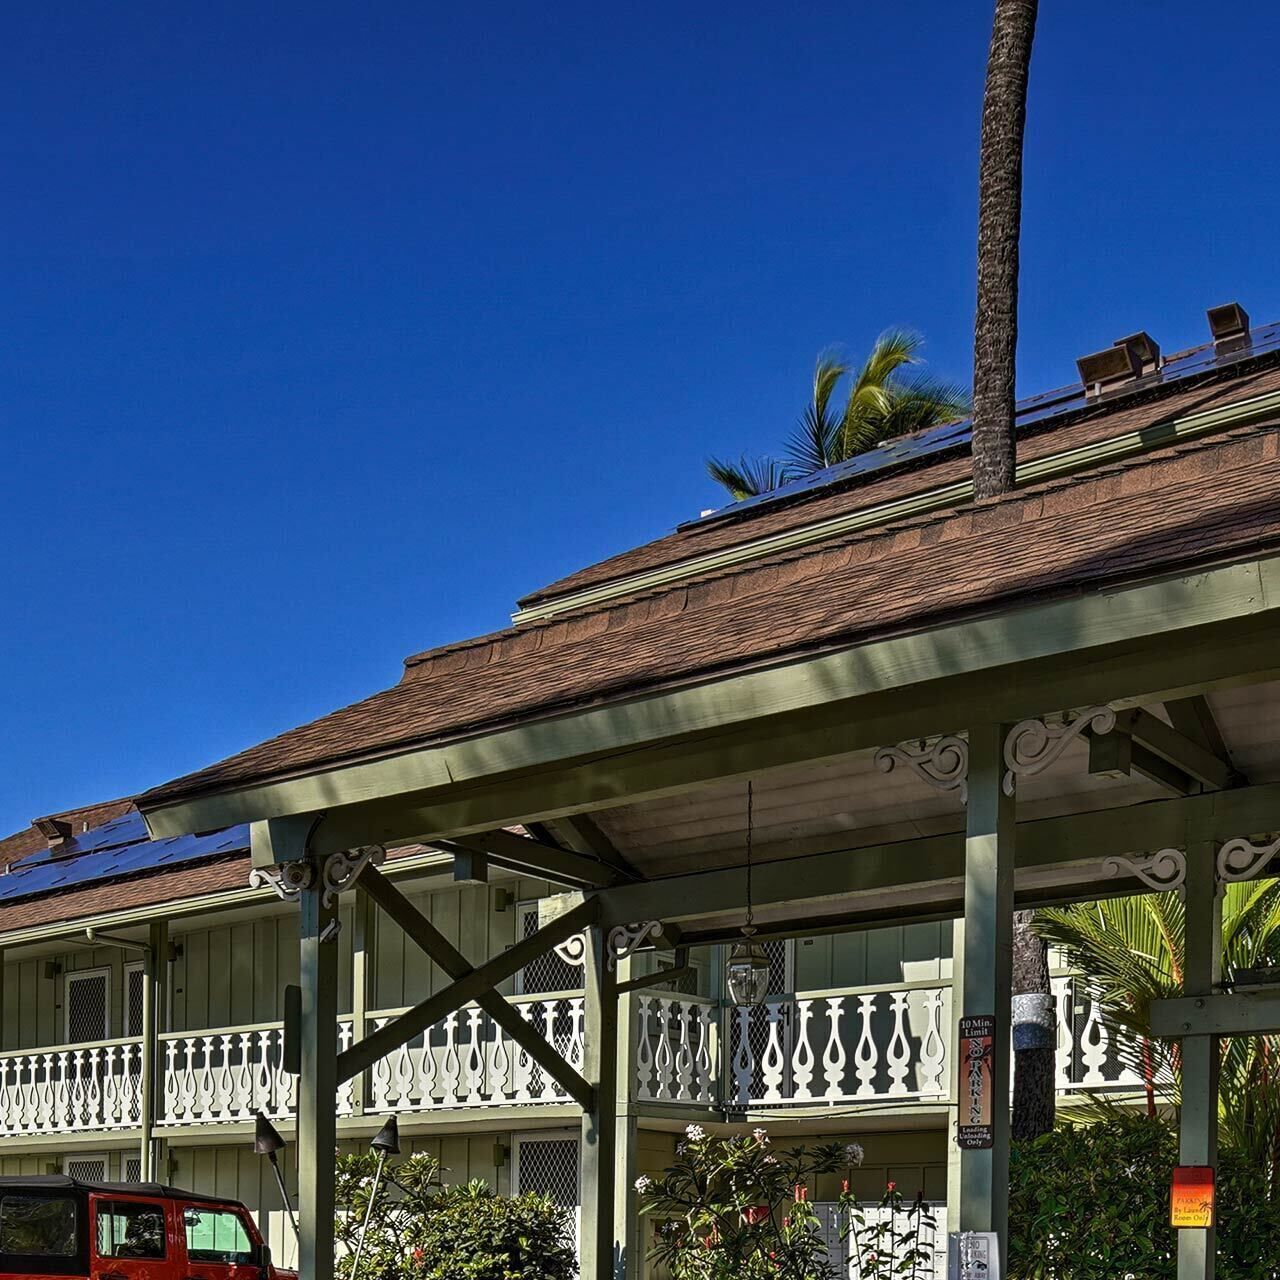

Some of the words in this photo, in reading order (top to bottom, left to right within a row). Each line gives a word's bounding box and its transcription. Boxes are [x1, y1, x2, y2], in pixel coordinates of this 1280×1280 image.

[961, 1019, 971, 1029] 10
[972, 1018, 993, 1028] Min.
[965, 1027, 988, 1037] Limit
[968, 1060, 984, 1126] PARKING
[966, 1139, 983, 1147] Only
